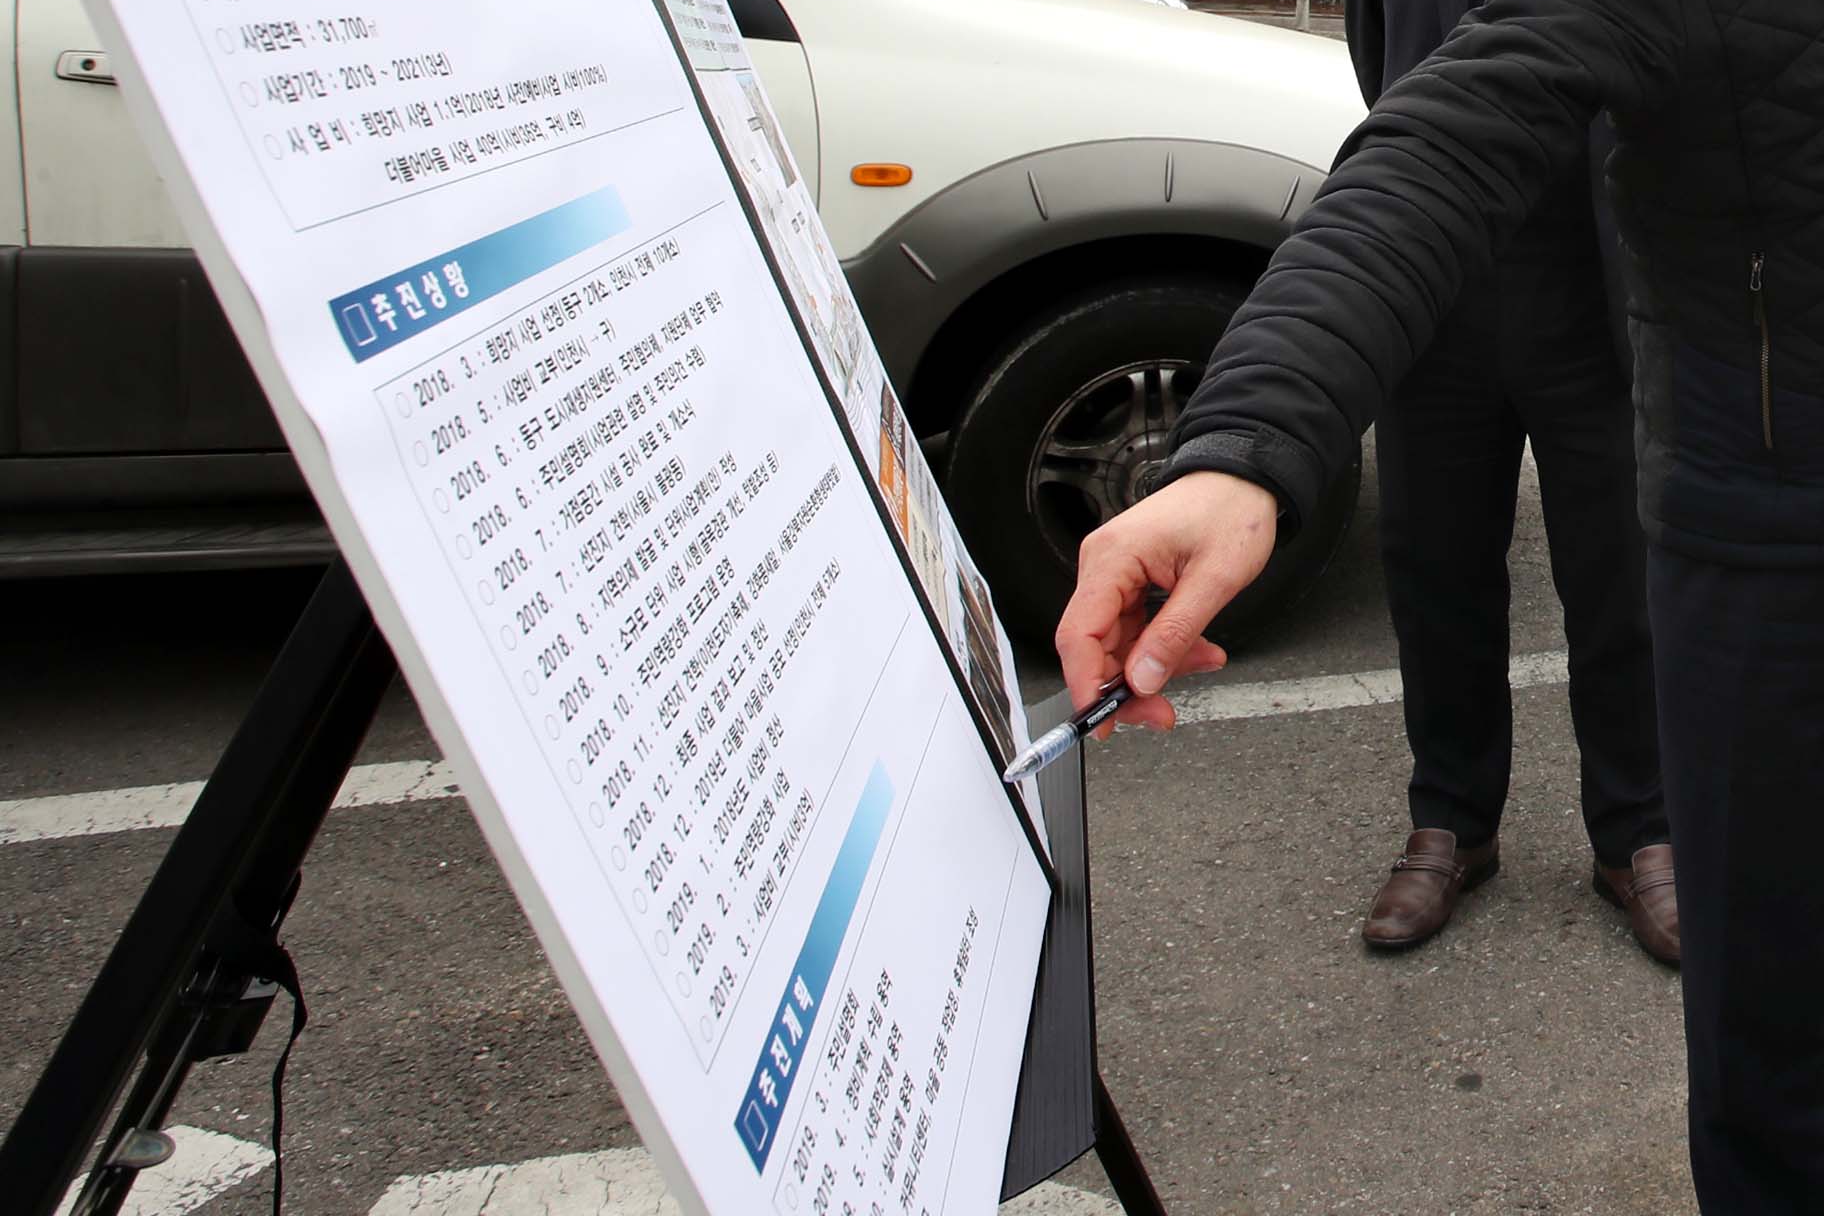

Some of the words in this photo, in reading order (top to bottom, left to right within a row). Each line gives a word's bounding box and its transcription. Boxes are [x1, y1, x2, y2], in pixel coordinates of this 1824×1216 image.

[240, 21, 306, 52] 사업면적
[264, 70, 328, 104] 사업기간
[339, 64, 376, 90] 2019
[392, 52, 453, 81] 2021(3년)
[287, 128, 308, 154] 사
[308, 123, 331, 152] 업
[328, 119, 351, 144] 비
[361, 107, 405, 137] 희망지
[406, 101, 434, 128] 사업
[384, 147, 450, 184] 더불어마을
[449, 139, 477, 165] 사업
[545, 114, 568, 136] 구비
[567, 108, 586, 129] 4억)
[370, 260, 469, 331] 추진상황
[413, 369, 455, 408] 2018.
[460, 356, 477, 379] 3.
[486, 328, 520, 364] 희망지
[518, 315, 543, 344] 사업
[540, 292, 583, 333] 선정(동구
[582, 279, 613, 306] 2개소,
[609, 261, 638, 291] 인천시
[634, 251, 655, 277] 전체
[431, 415, 471, 455] 2018.
[477, 400, 493, 424] 5.
[503, 368, 537, 406] 사업비
[534, 335, 590, 384] 교부(인천시
[599, 318, 616, 342] 구)
[450, 460, 490, 501] 2018.
[495, 444, 512, 467] 6.
[518, 416, 544, 450] 동구
[661, 310, 693, 344] 지원단체
[689, 301, 707, 325] 업무
[472, 504, 512, 546] 2018.
[515, 487, 532, 509] 6.
[539, 405, 628, 490] 주민설명회(사업관련
[625, 391, 646, 421] 설명
[643, 382, 658, 406] 및
[654, 359, 689, 396] 주민의견
[494, 548, 532, 591] 2018.
[534, 529, 553, 552] 7.
[558, 480, 603, 530] 거점공간
[600, 462, 623, 493] 시설
[619, 445, 642, 477] 공사
[638, 430, 660, 460] 완료
[656, 419, 672, 443] 및
[668, 399, 696, 431] 개소식
[516, 591, 553, 635] 2018.
[555, 570, 573, 594] 7.
[579, 527, 613, 573] 선진지
[609, 481, 659, 542] 견학(서울시
[538, 634, 574, 680] 2018.
[576, 613, 592, 635] 8.
[597, 557, 640, 610] 지역의제
[634, 537, 658, 572] 발굴
[653, 524, 669, 551] 및
[719, 451, 737, 476] 작성
[559, 676, 594, 723] 2018.
[596, 654, 612, 676] 9.
[619, 606, 649, 652] 소규모
[645, 582, 669, 618] 단위
[665, 561, 686, 594] 사업
[726, 491, 745, 519] 개선,
[766, 450, 779, 474] 등)
[580, 718, 615, 766] 2018.
[613, 694, 633, 722] 10.
[637, 613, 690, 688] 주민역량강화
[686, 574, 720, 626] 프로그램
[716, 555, 735, 588] 운영
[602, 760, 635, 809] 2018.
[633, 735, 653, 762] 11.
[657, 680, 687, 730] 선진지
[624, 801, 656, 852] 2018.
[653, 774, 672, 802] 12.
[675, 728, 698, 768] 최종
[695, 701, 716, 738] 사업
[710, 676, 731, 713] 결과
[727, 654, 746, 688] 보고
[742, 639, 756, 665] 및
[645, 842, 677, 894] 2018.
[674, 814, 693, 842] 12.
[694, 749, 727, 806] 2019년
[722, 712, 749, 757] 더불어
[744, 668, 774, 720] 마을사업
[769, 648, 787, 680] 공모
[783, 598, 816, 658] 선정(인천시
[811, 581, 827, 610] 전체
[667, 882, 697, 935] 2019.
[699, 854, 713, 874] 1.
[713, 777, 750, 845] 2018년도
[746, 738, 771, 784] 사업비
[687, 923, 716, 976] 2019.
[717, 893, 731, 917] 2.
[734, 795, 776, 880] 주민역량강화
[772, 767, 790, 803] 사업
[710, 965, 737, 1020] 2019.
[736, 935, 751, 957] 3.
[753, 868, 778, 923] 사업비
[773, 788, 814, 878] 교부(시비3억)
[758, 974, 814, 1108] 추진계획
[793, 1126, 818, 1184] 2019.
[815, 1091, 829, 1114] 3.
[827, 987, 860, 1072] 주민설명회
[813, 1163, 837, 1216] 2019.
[835, 1128, 847, 1148] 4.
[845, 1036, 872, 1111] 정비계획
[867, 1001, 883, 1040] 수립
[877, 968, 893, 1008] 용역
[853, 1164, 866, 1187] 5.
[864, 1055, 894, 1147] 사회적경제
[887, 1020, 903, 1062] 용역
[882, 1106, 906, 1184] 실시설계
[899, 1070, 915, 1113] 용역
[925, 1067, 940, 1106] 마을
